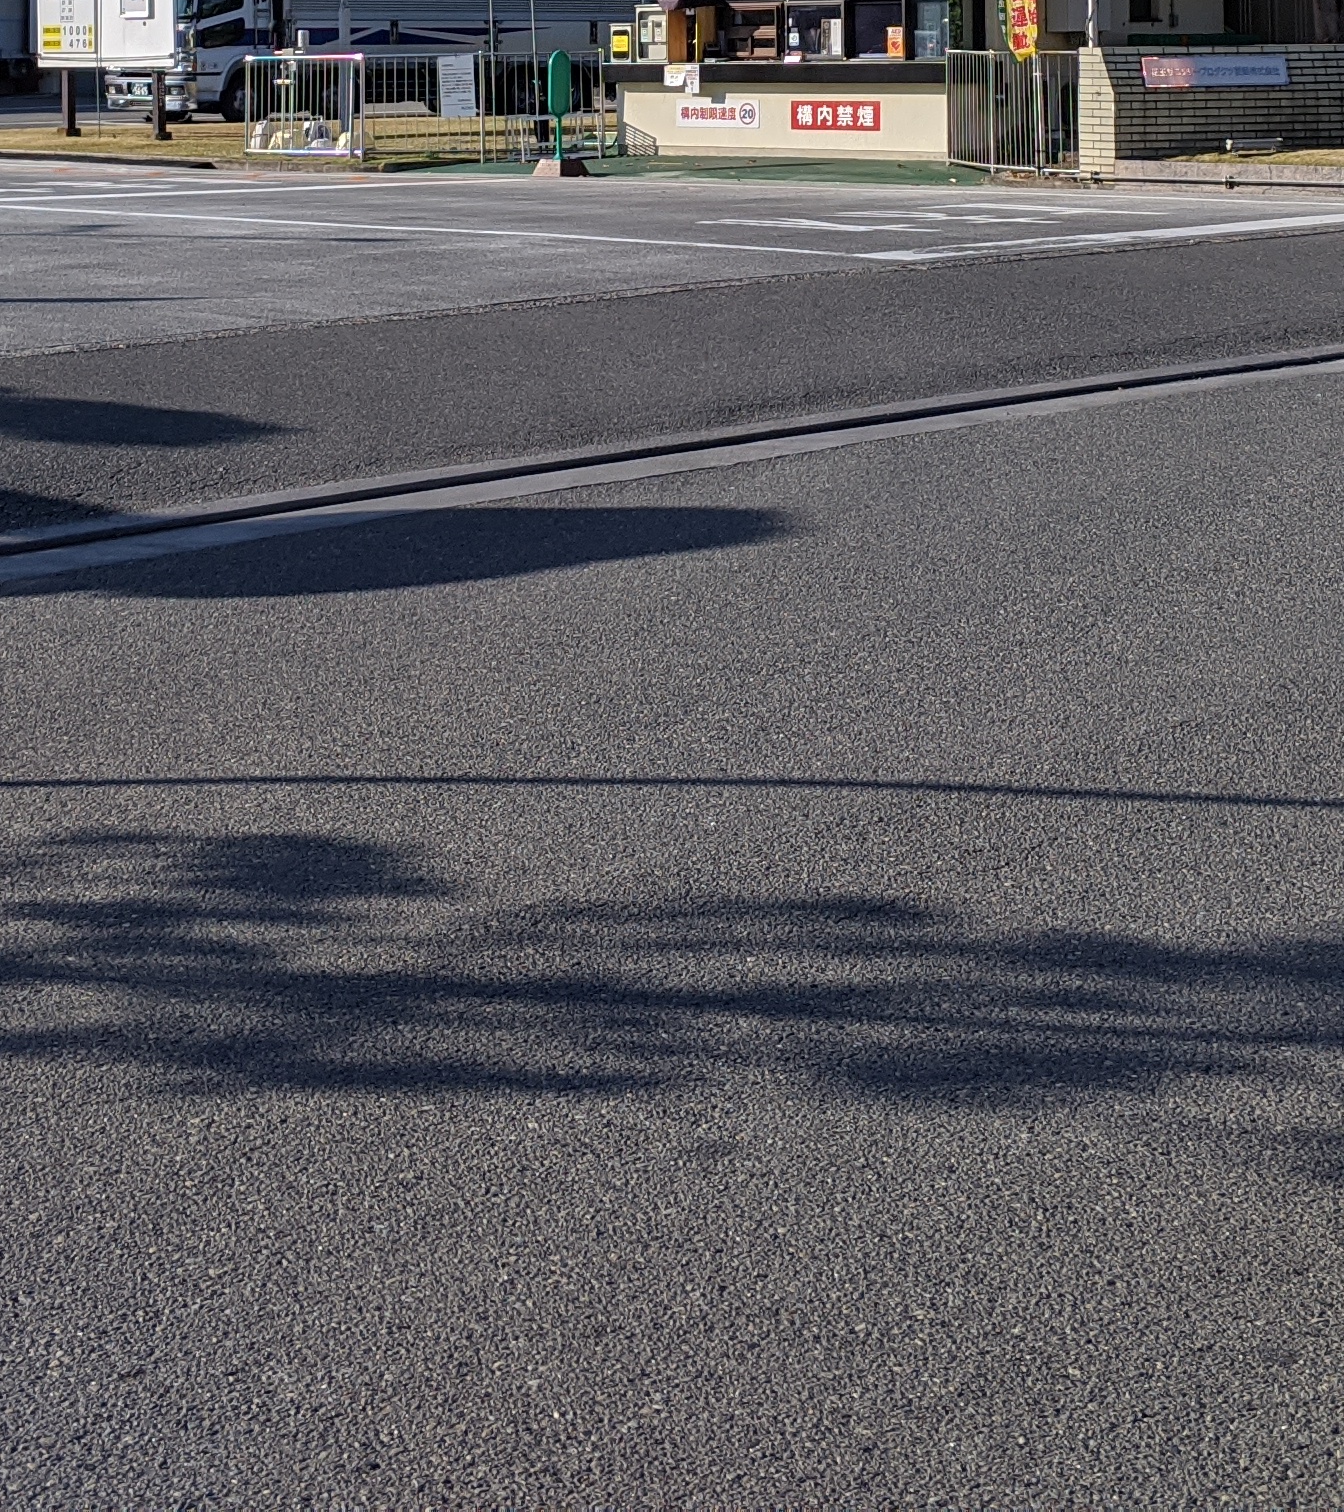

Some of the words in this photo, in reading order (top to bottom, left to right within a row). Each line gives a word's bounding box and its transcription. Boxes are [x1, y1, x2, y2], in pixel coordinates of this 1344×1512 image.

[681, 107, 736, 120] 構内制限速度
[741, 109, 754, 119] 20
[797, 104, 874, 127] 構内禁煙
